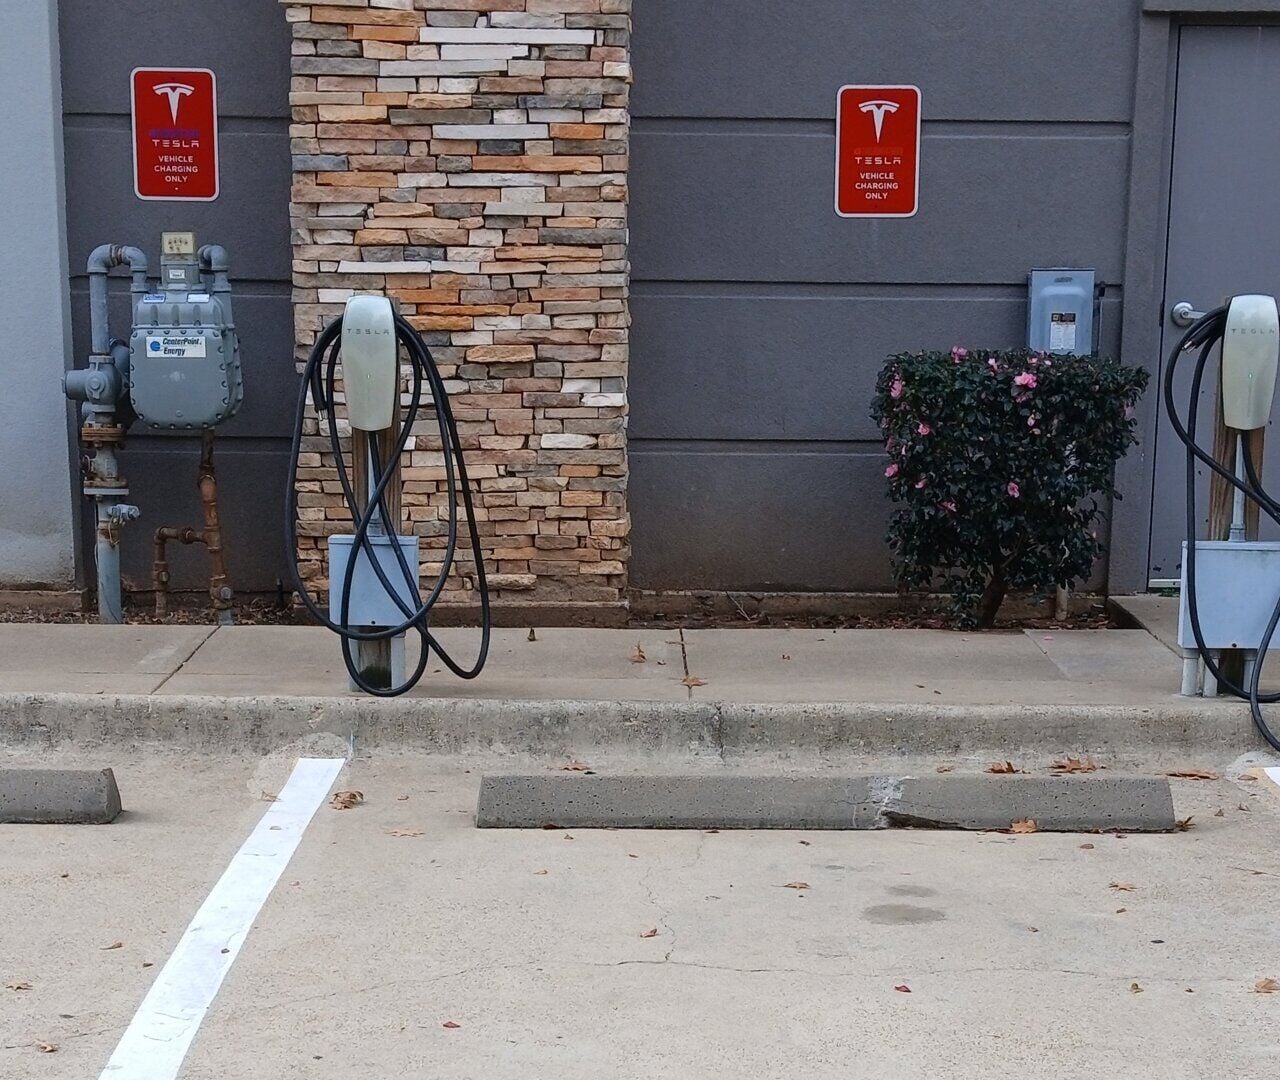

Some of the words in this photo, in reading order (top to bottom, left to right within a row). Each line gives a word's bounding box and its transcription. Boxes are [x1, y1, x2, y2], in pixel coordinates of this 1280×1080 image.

[152, 139, 199, 148] TESLA
[854, 157, 901, 165] TESLA
[154, 165, 198, 173] CHARGING
[859, 172, 894, 180] VEHICLE
[855, 182, 898, 190] CHARGING
[865, 192, 888, 200] ONLY
[162, 337, 199, 345] CenterPoint
[163, 347, 186, 356] Energy
